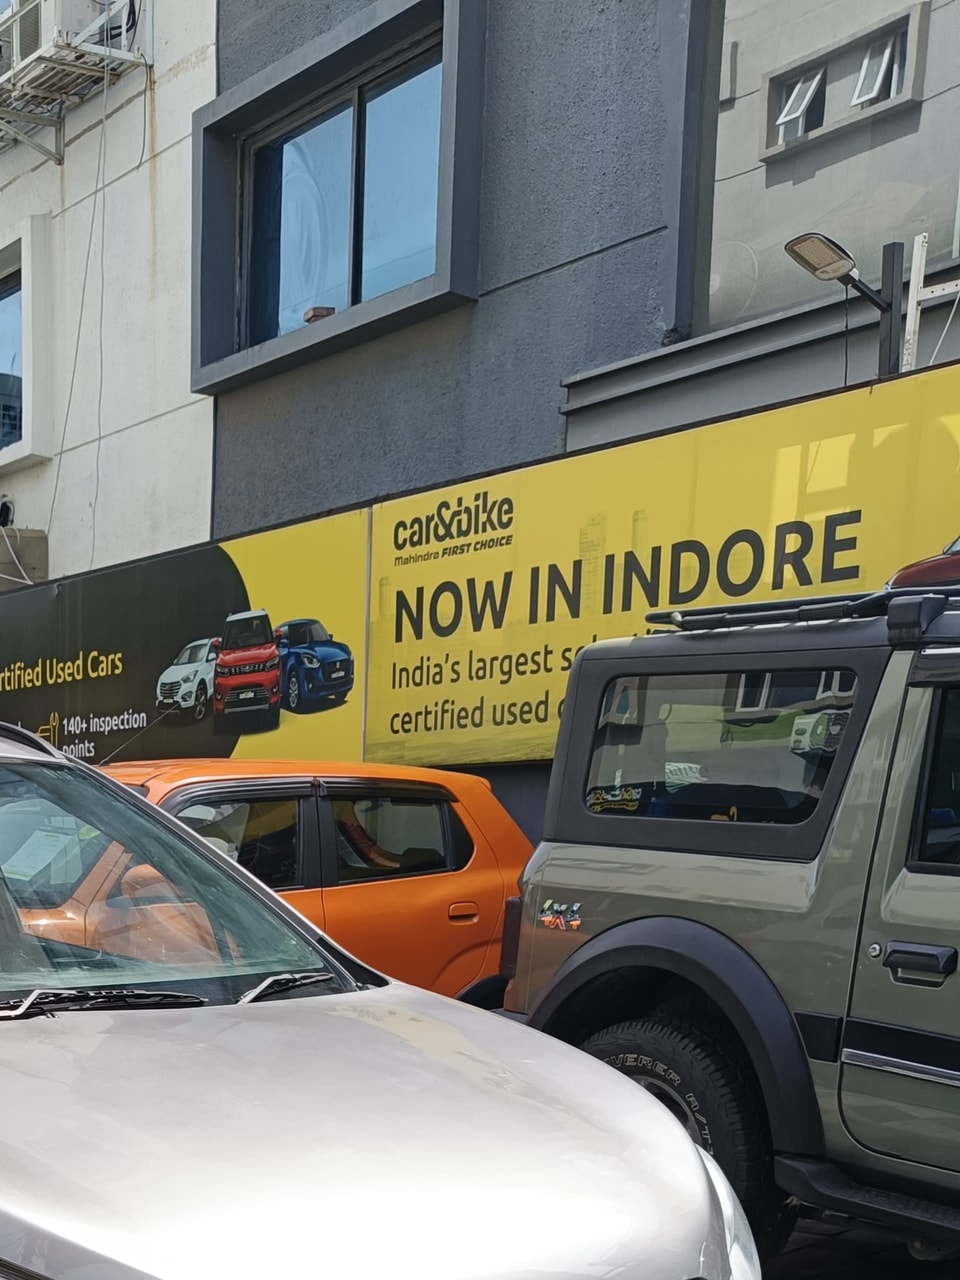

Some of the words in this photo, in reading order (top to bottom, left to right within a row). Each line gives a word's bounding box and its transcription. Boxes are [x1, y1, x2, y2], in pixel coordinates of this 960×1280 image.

[393, 491, 514, 551] car&bike
[394, 551, 439, 567] Mahindra
[441, 543, 472, 558] FIRST
[473, 534, 513, 552] CHOICE
[395, 571, 513, 643] NOW
[529, 559, 582, 625] IN
[603, 509, 862, 615] INDORE
[46, 651, 83, 685] Used
[87, 651, 123, 678] Cars
[391, 653, 461, 689] India's
[468, 644, 553, 685] largest
[62, 716, 87, 736] 140+
[89, 708, 147, 735] inspection
[390, 696, 485, 735] certified
[492, 690, 549, 726] used
[62, 740, 95, 758] points
[603, 1054, 681, 1087] VERER
